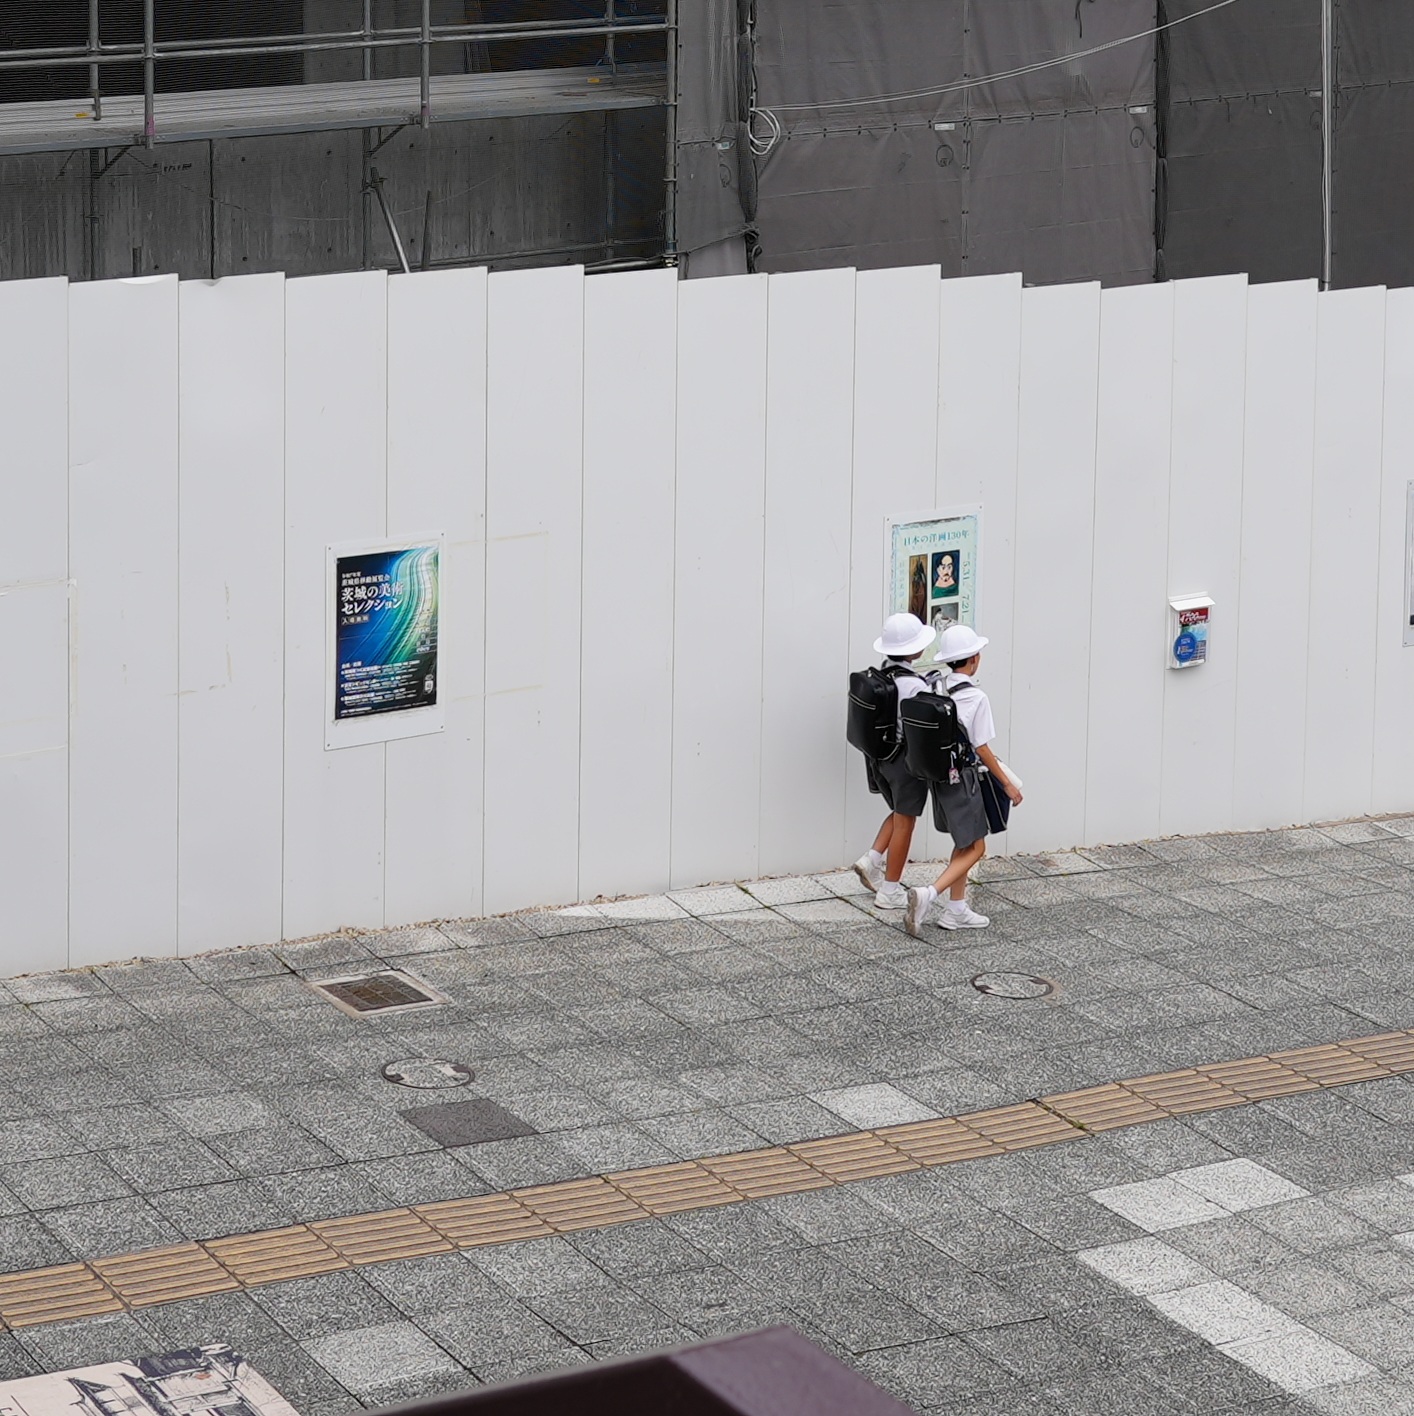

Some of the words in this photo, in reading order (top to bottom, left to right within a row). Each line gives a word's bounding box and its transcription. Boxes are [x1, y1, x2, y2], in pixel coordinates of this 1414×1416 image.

[341, 583, 404, 603] 茨城の美術
[341, 598, 404, 615] セレクション
